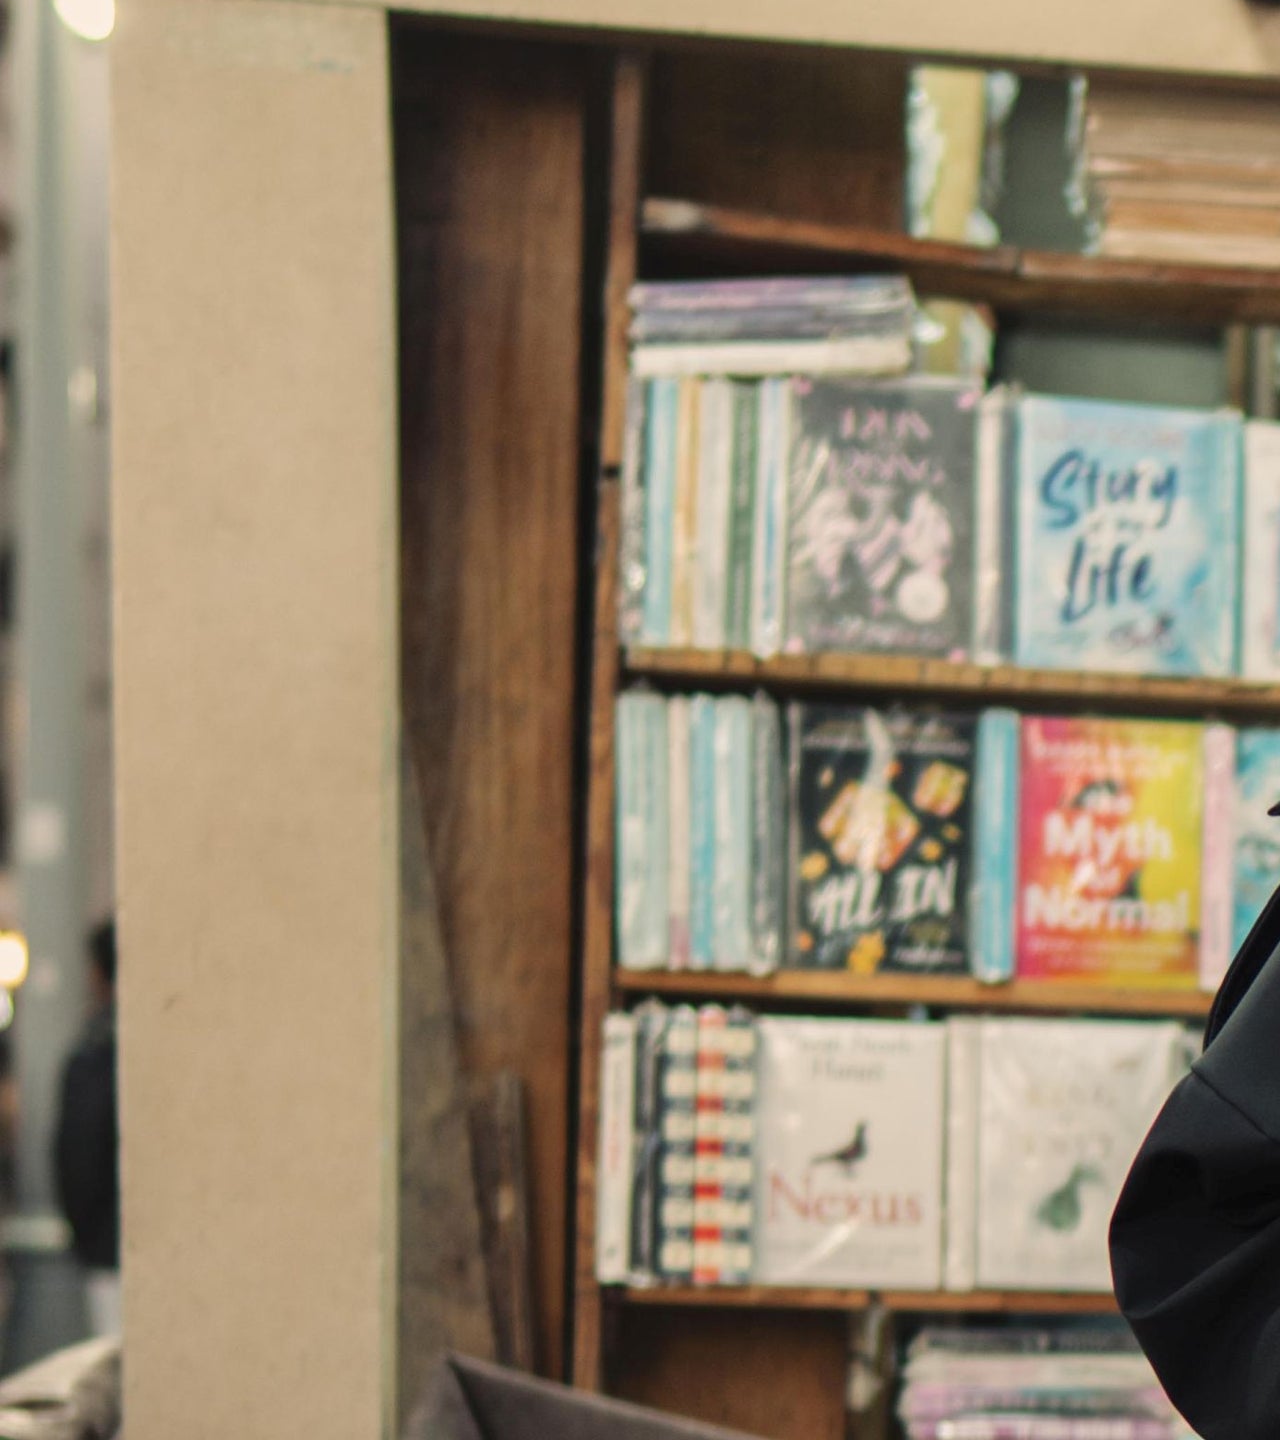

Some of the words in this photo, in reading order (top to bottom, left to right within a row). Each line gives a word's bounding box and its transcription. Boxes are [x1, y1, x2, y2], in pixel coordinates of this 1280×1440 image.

[1062, 535, 1158, 623] Life
[1043, 812, 1173, 860] Myth
[888, 858, 958, 921] IN
[1025, 882, 1190, 932] Normal
[767, 1167, 923, 1226] Nexus
